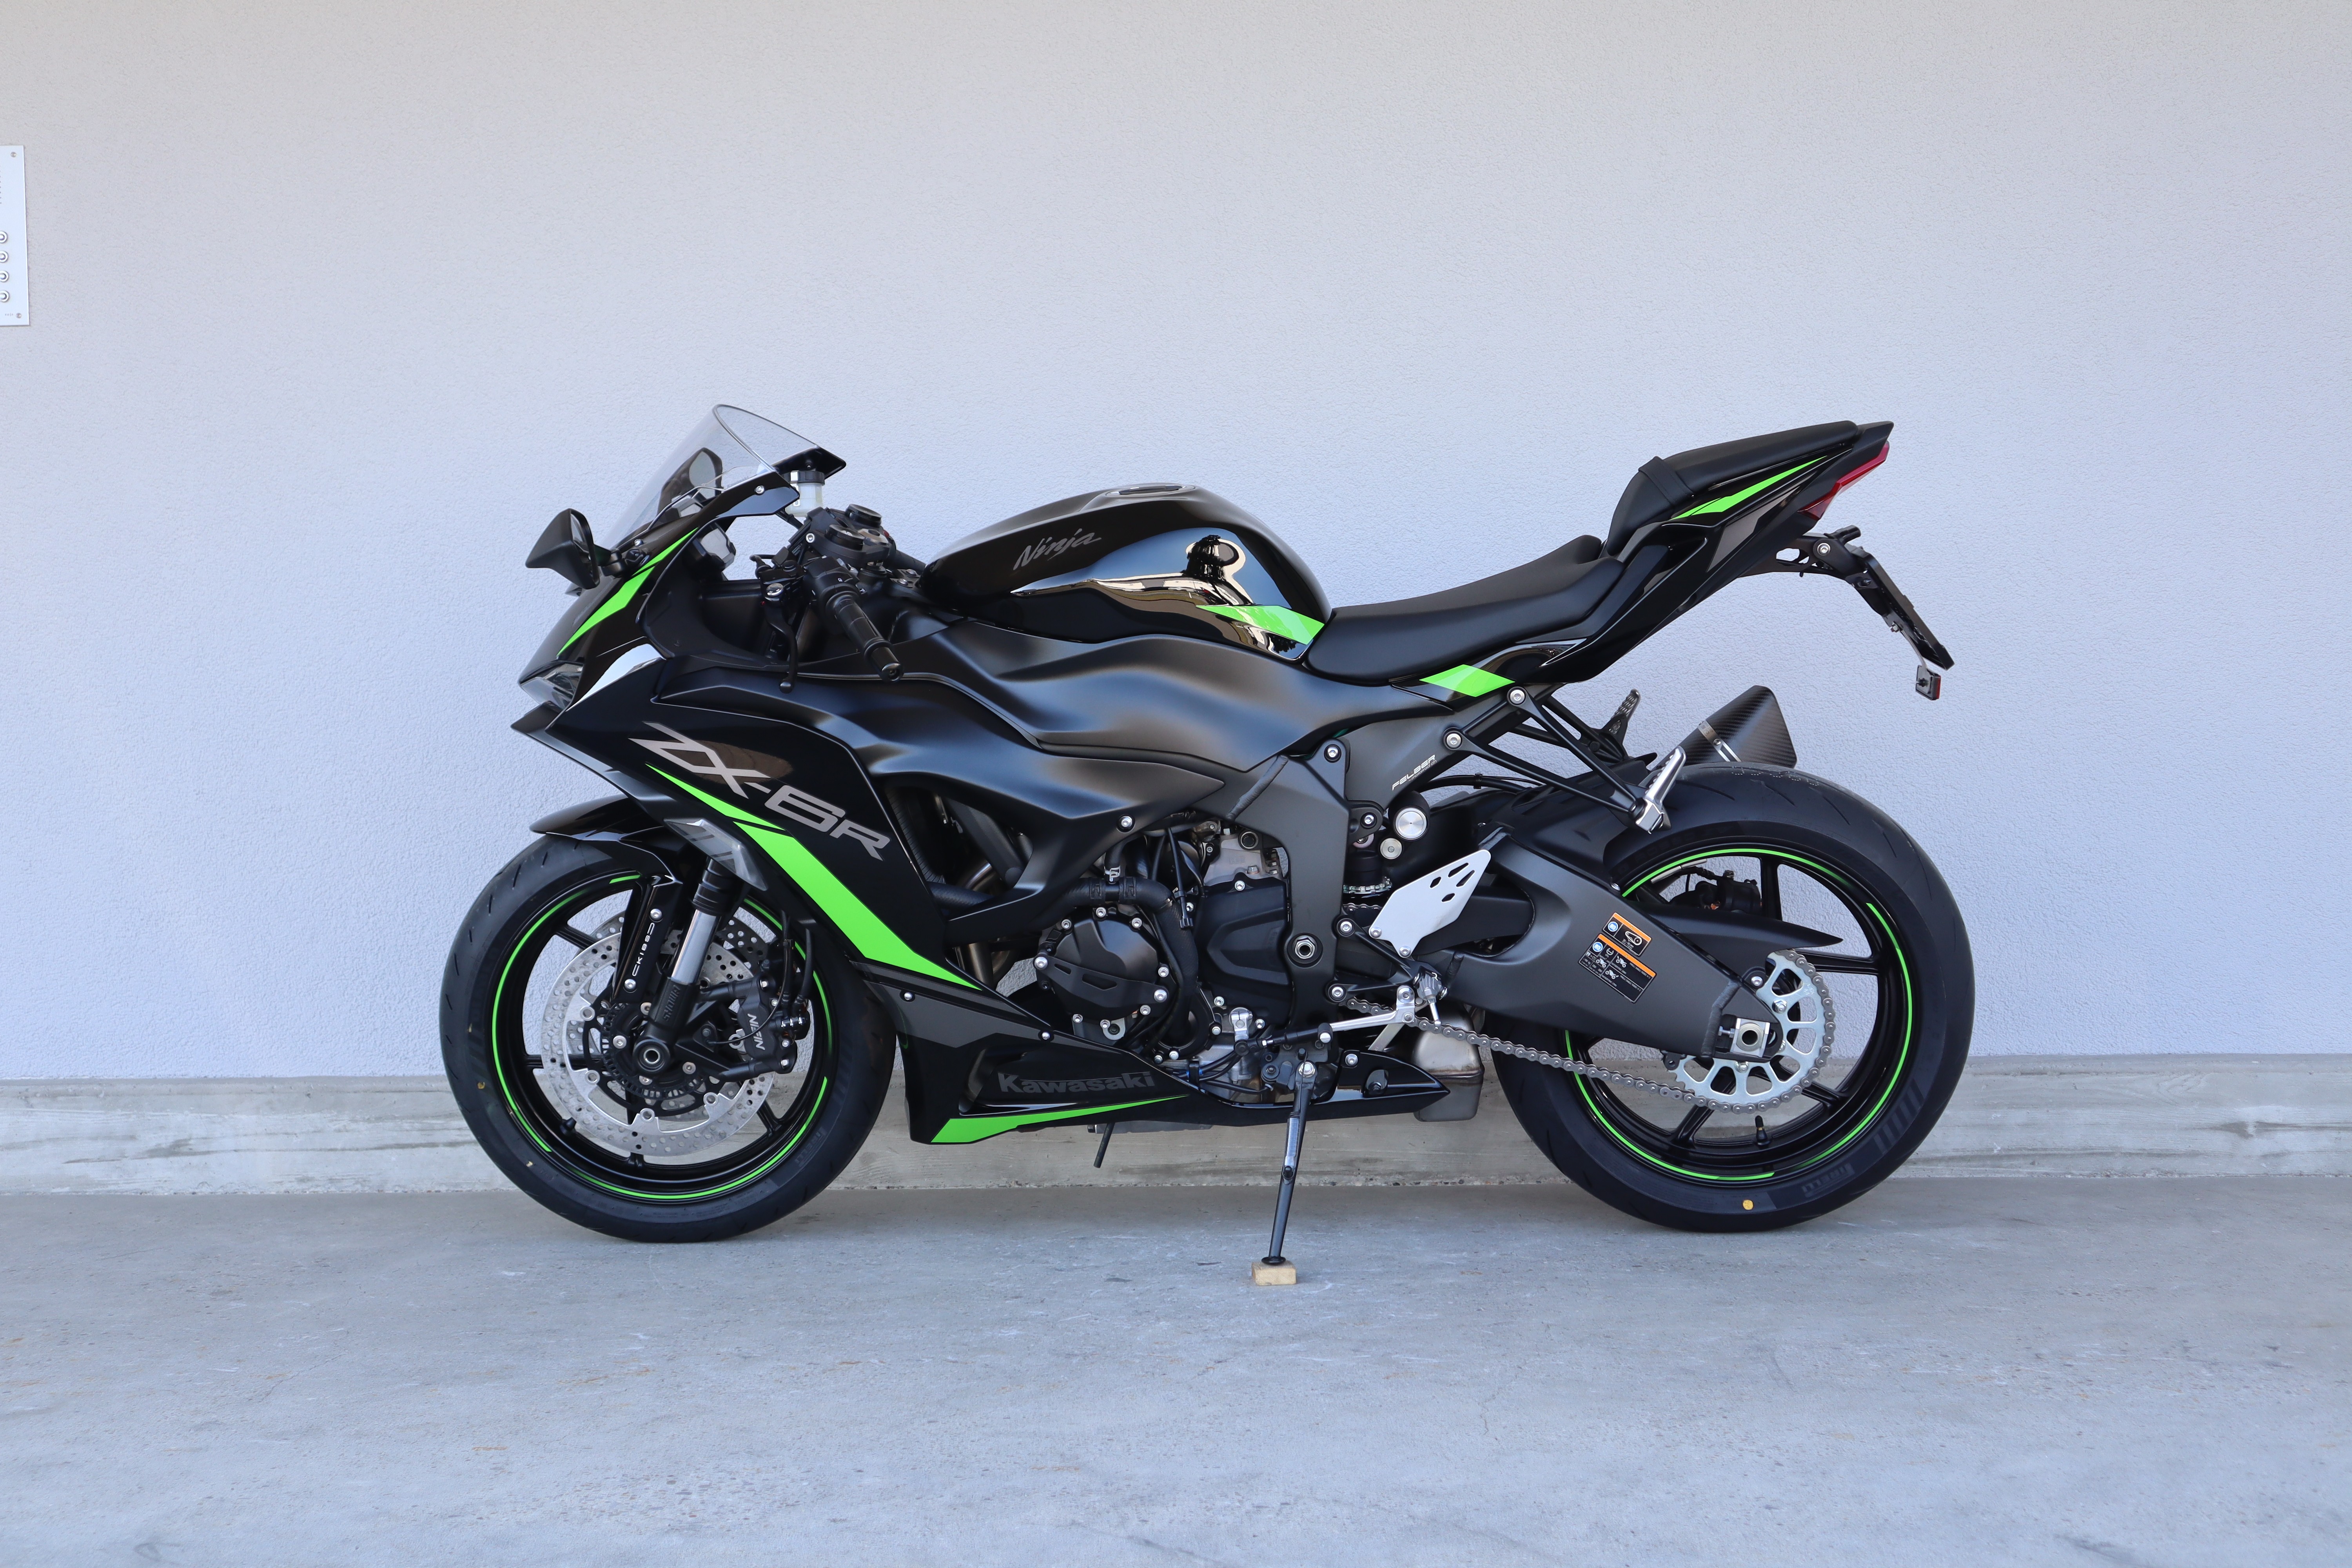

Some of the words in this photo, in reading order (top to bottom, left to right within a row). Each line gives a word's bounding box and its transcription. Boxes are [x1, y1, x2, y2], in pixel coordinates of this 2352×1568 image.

[1013, 528, 1102, 571] Ninja
[628, 721, 890, 861] ZX-6R
[1392, 754, 1436, 791] FELBER
[636, 935, 650, 965] KIBS
[997, 1071, 1155, 1094] Kawasaki
